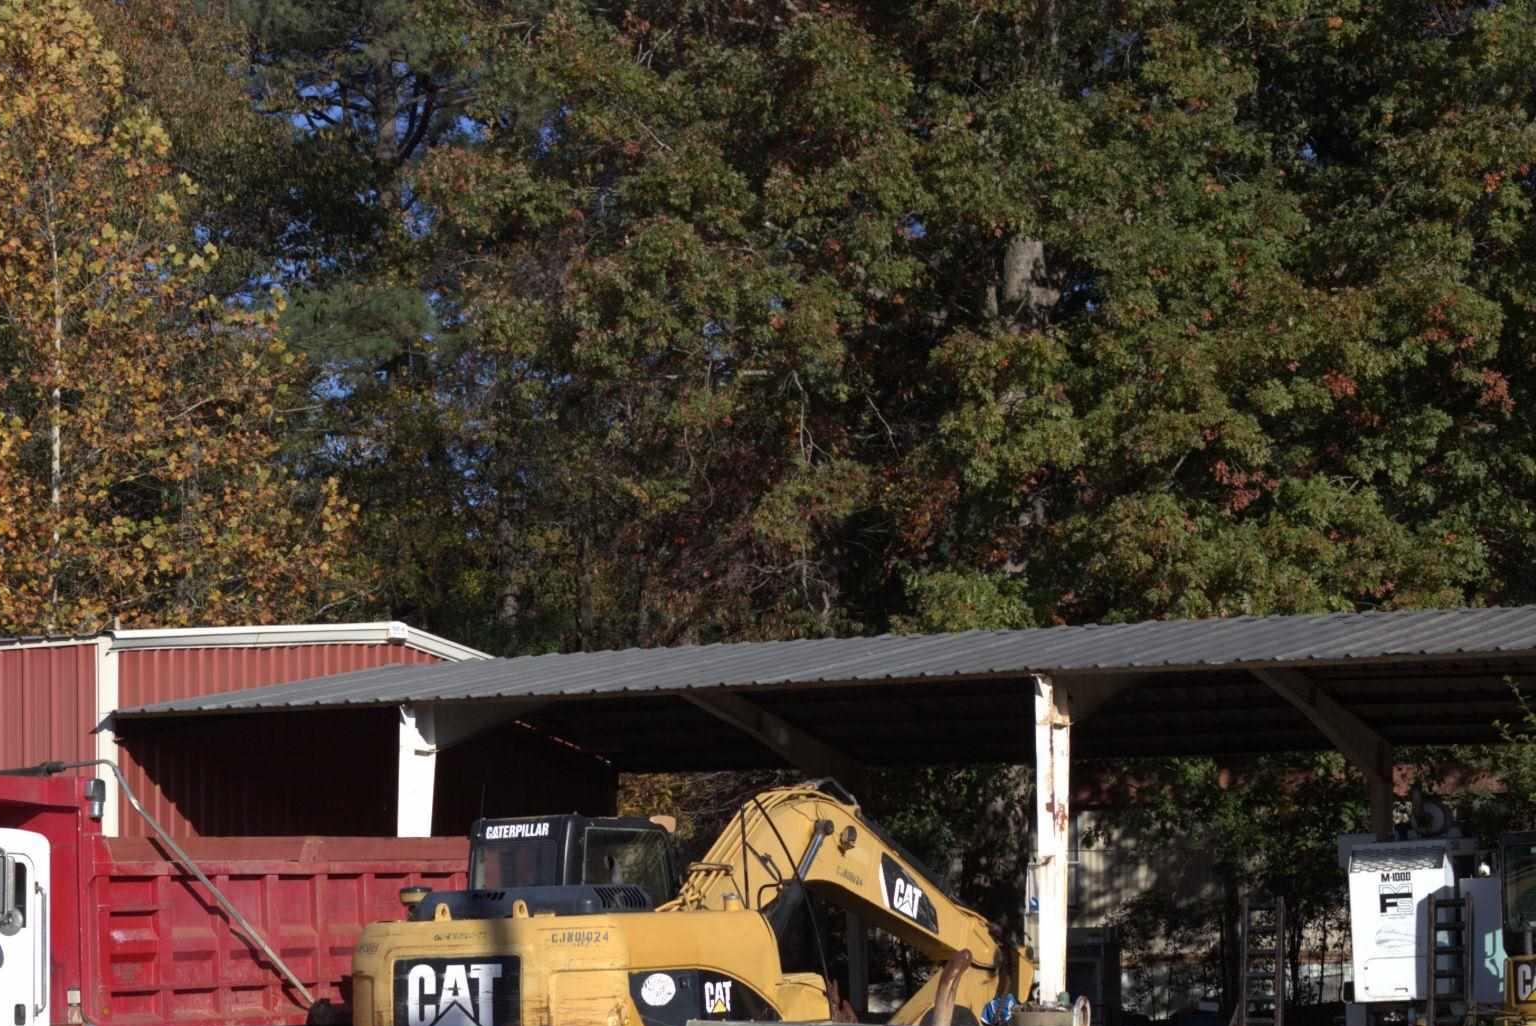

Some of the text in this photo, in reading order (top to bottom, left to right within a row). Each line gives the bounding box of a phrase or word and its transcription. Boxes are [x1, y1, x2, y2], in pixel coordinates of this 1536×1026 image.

[486, 823, 549, 839] CATERPILLAR
[893, 877, 922, 919] CAT
[704, 981, 732, 1013] CAT
